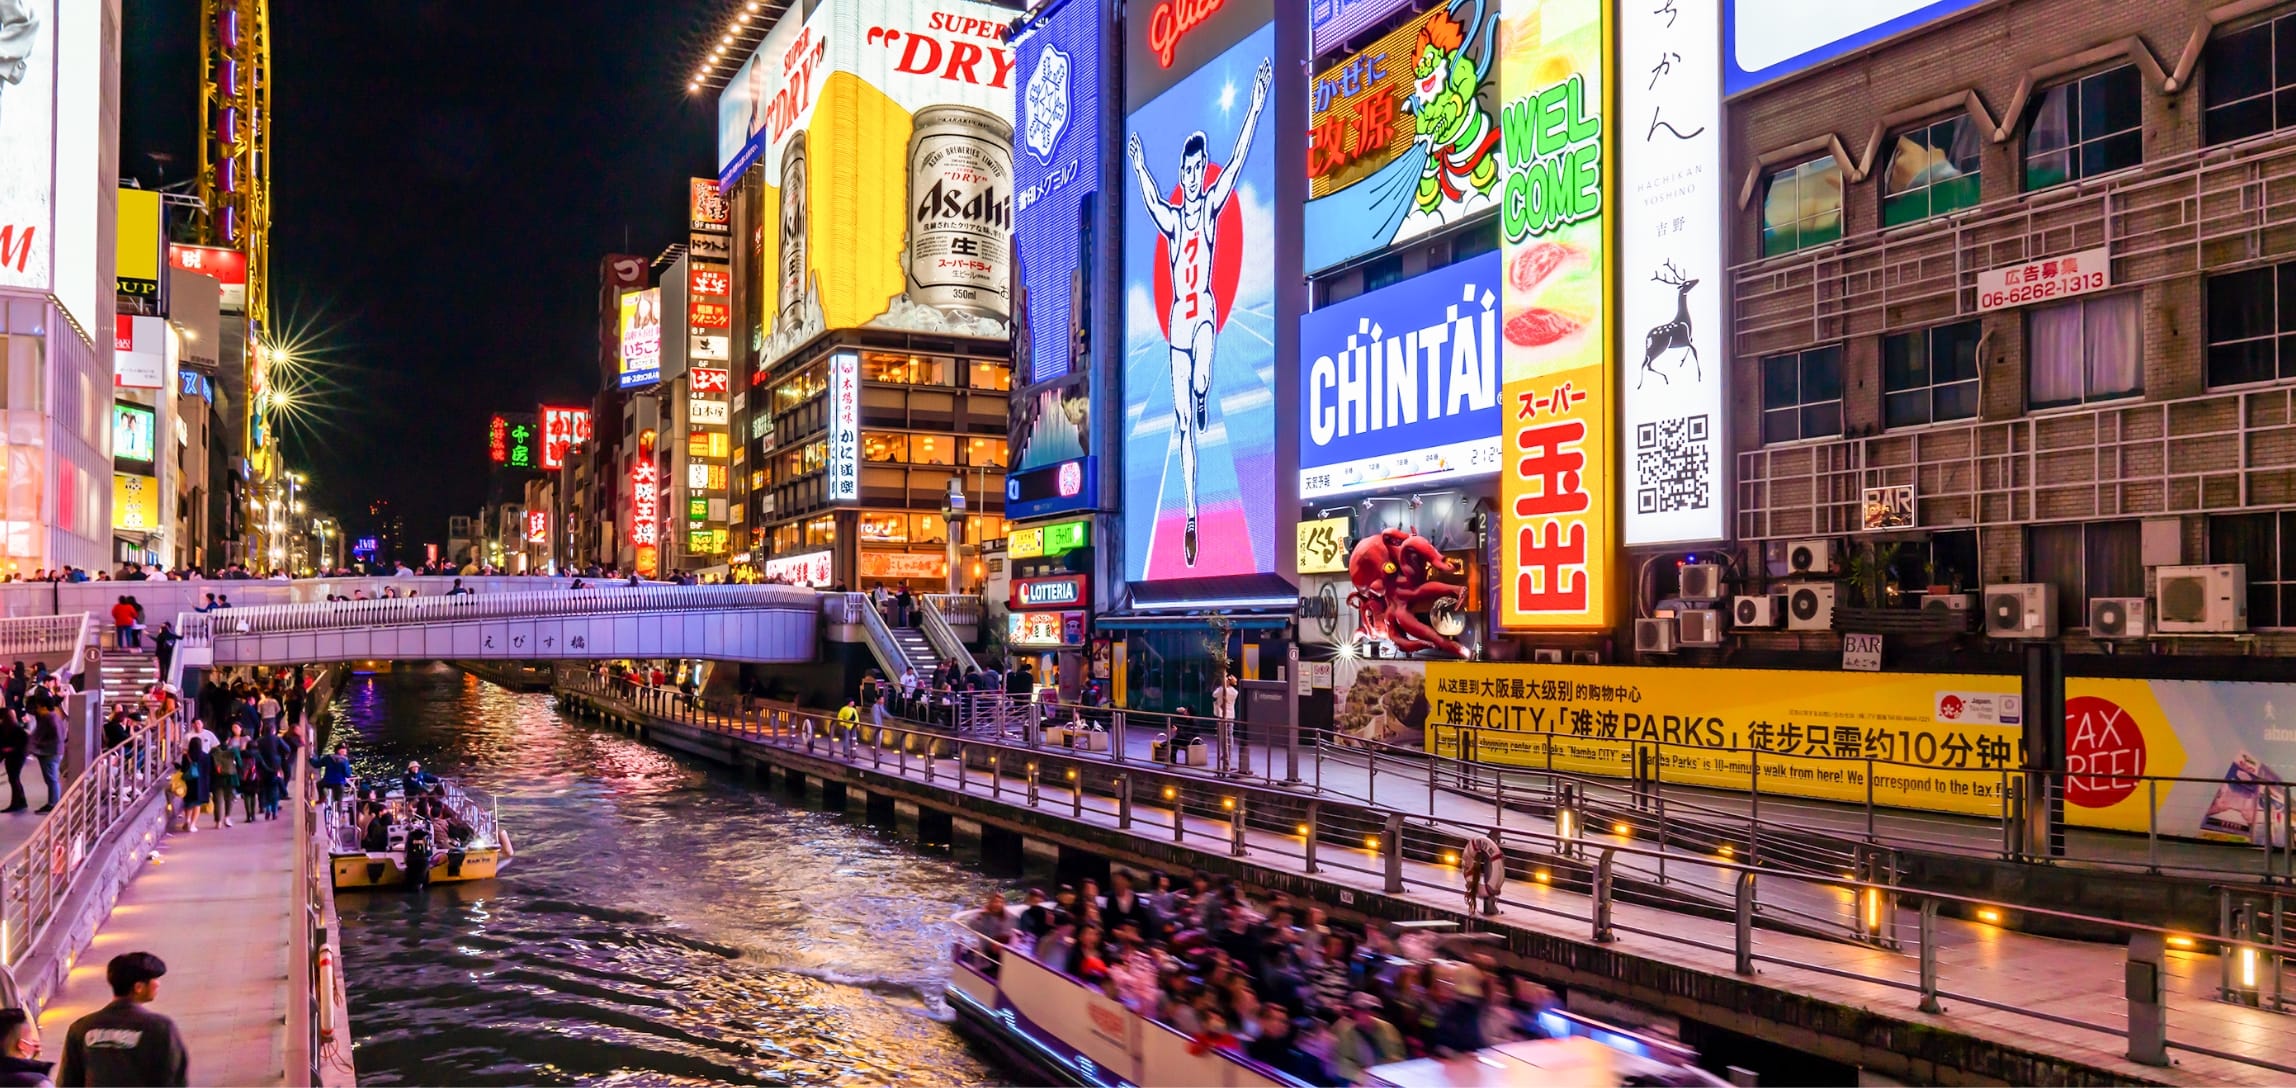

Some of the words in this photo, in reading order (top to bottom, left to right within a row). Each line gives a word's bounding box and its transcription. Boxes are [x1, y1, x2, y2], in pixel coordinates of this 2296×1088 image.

[783, 26, 810, 78] SUPER
[1314, 52, 1388, 113] かぜに
[1306, 84, 1395, 179] 改源
[1503, 77, 1599, 169] WEL
[946, 145, 980, 158] BREWERIES
[1503, 144, 1598, 237] COME
[1638, 164, 1702, 192] HACHIKAN
[1643, 183, 1695, 207] YOSHINO
[917, 178, 1010, 231] Asahi
[938, 258, 992, 273] スーパードライ
[951, 237, 979, 257] 生
[1184, 231, 1200, 320] グリコ
[1982, 272, 2104, 308] 06-6262-1313
[2004, 257, 2079, 286] 広告募集
[953, 288, 977, 300] 350ml
[1310, 284, 1496, 446] CHINTAI
[1519, 383, 1586, 420] スーパー
[840, 429, 854, 494] かに道楽
[1305, 474, 1331, 490] 天気予報
[1866, 487, 1912, 513] BAR
[633, 461, 656, 544] 大阪王将
[1516, 422, 1588, 611] 玉出
[1307, 526, 1338, 564] くくる
[1030, 582, 1074, 601] LOTTERIA
[484, 635, 585, 649] えびす橋
[1845, 636, 1881, 654] BAR
[1479, 739, 1508, 754] shopping
[1510, 742, 1532, 753] center
[1533, 744, 1540, 754] in
[1542, 742, 1566, 757] Oaka,
[1703, 758, 1711, 770] is
[1715, 759, 1760, 776] 10-minue
[1763, 764, 1786, 777] walk
[1790, 766, 1814, 780] from
[1817, 766, 1843, 784] here!
[1847, 770, 1864, 785] We
[1935, 778, 1946, 792] to
[1950, 779, 1969, 796] the
[1973, 781, 1992, 797] tax
[2066, 749, 2139, 793] REE!
